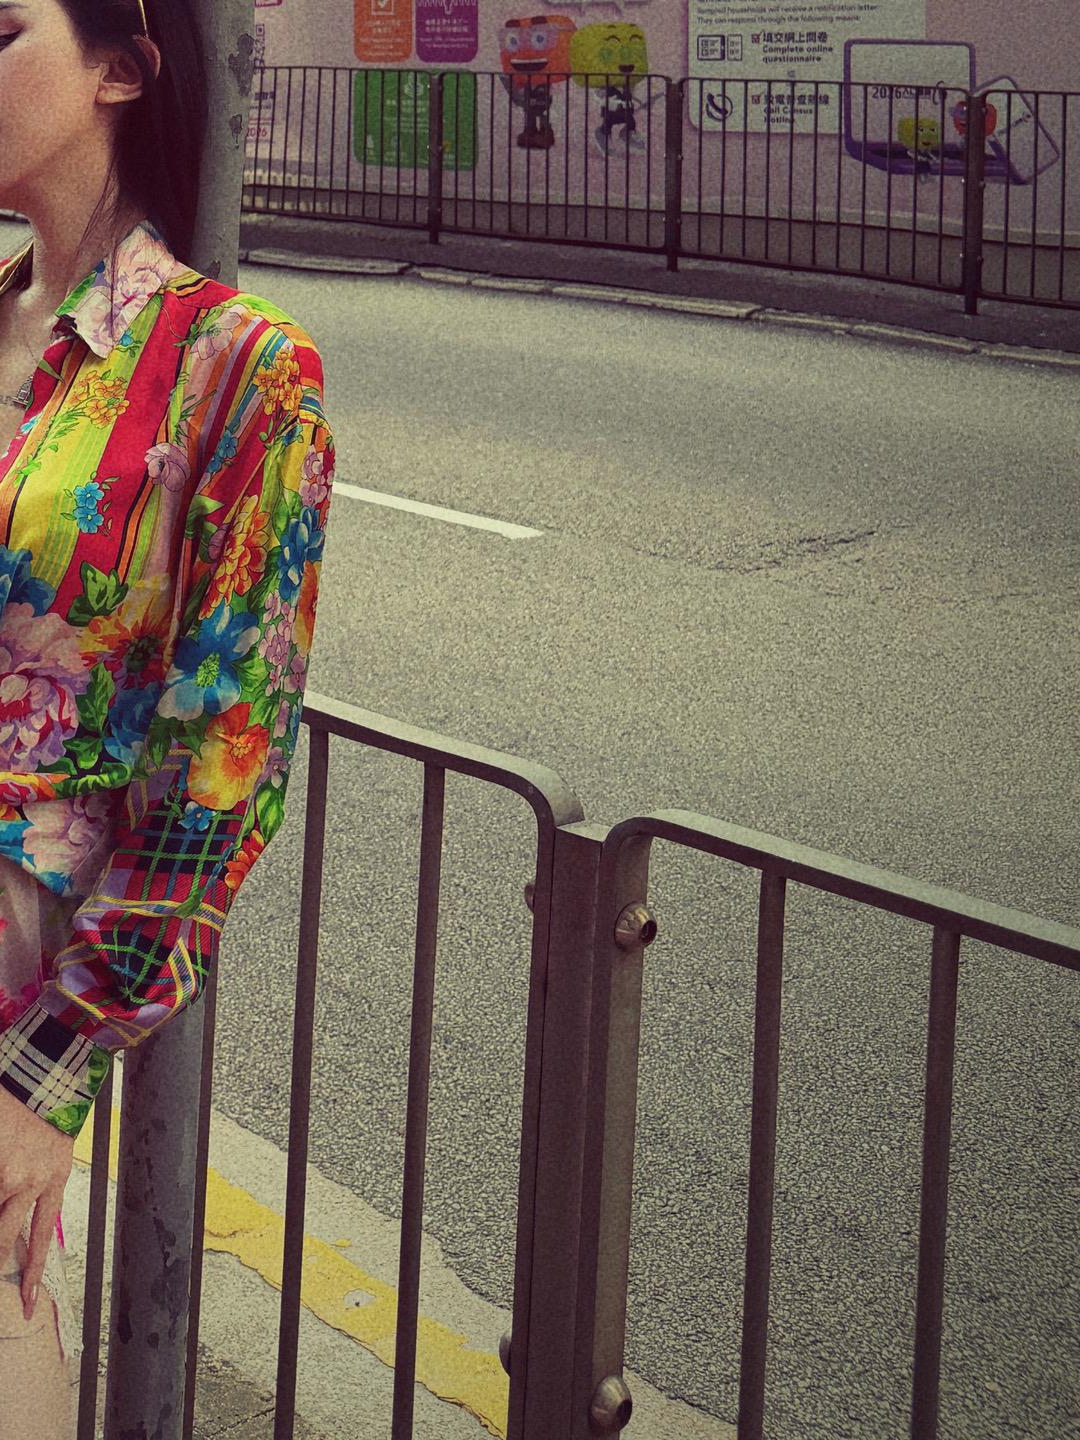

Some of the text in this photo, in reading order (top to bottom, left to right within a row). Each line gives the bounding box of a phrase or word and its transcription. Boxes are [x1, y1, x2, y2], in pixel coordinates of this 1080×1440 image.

[763, 43, 833, 54] Complete online
[763, 54, 822, 64] questionnaire
